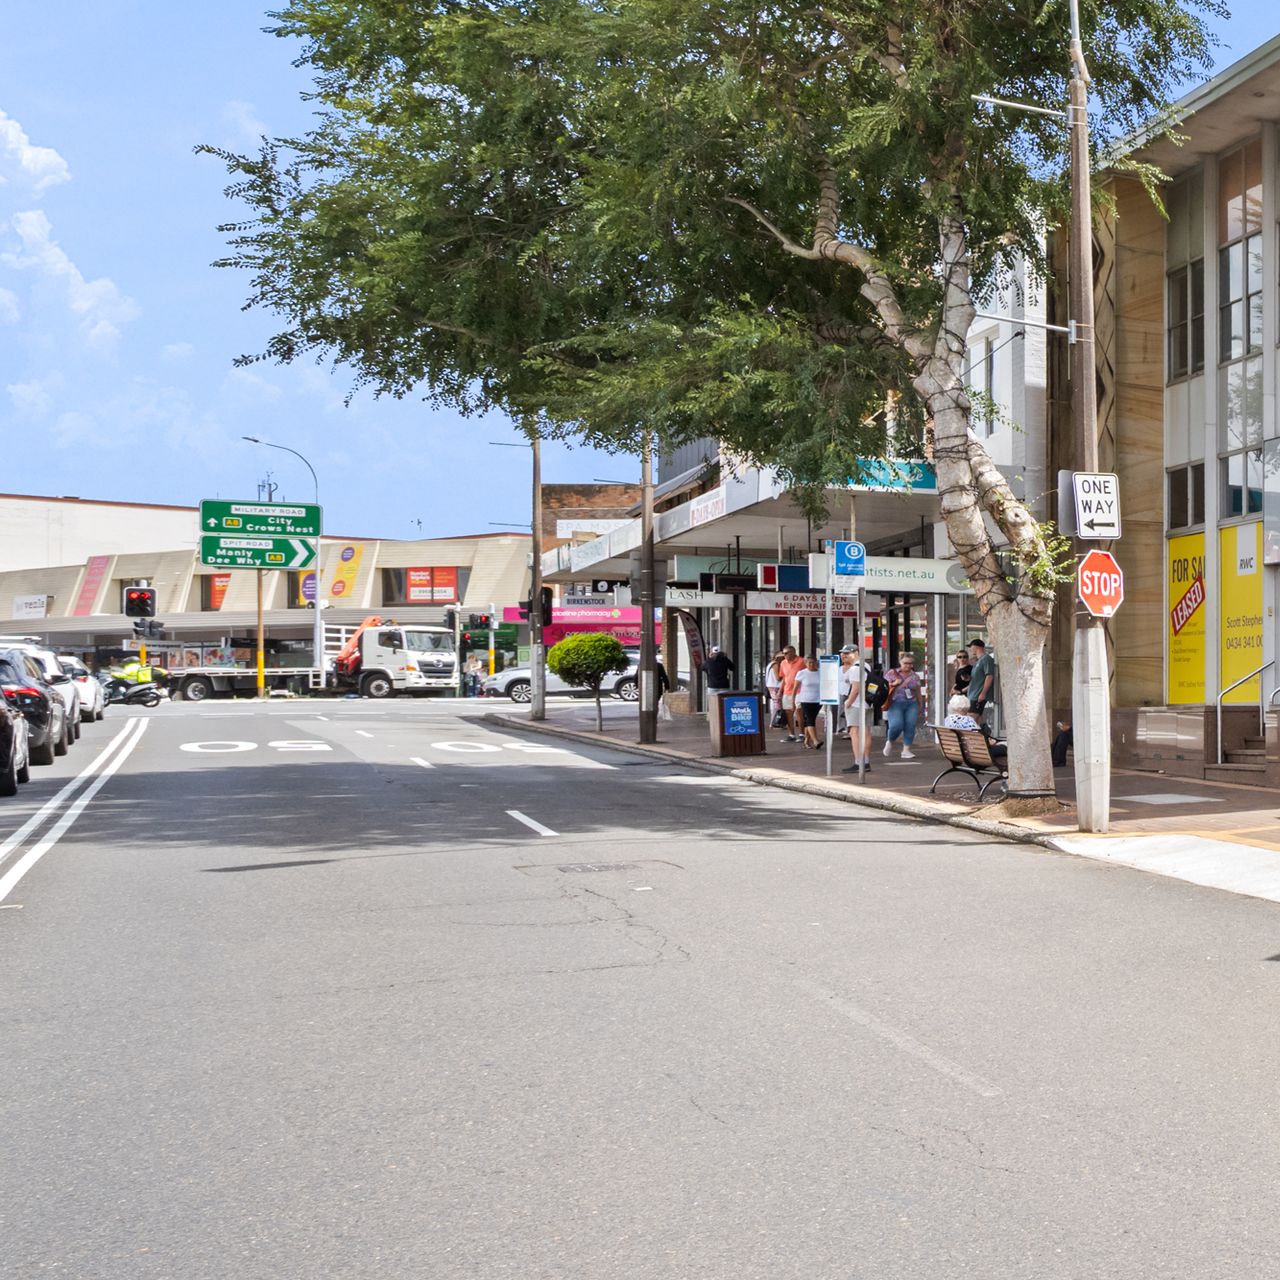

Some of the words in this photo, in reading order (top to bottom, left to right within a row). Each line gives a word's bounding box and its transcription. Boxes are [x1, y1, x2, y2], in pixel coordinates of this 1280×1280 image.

[1081, 479, 1112, 495] ONE
[233, 506, 276, 514] MILITARY
[280, 508, 304, 516] ROAD
[1081, 500, 1114, 514] WAY
[267, 517, 293, 526] City
[246, 524, 282, 532] Crows
[215, 549, 253, 558] Manly
[236, 557, 262, 566] Why
[1239, 557, 1254, 570] RWC
[1172, 559, 1189, 583] FOR
[1082, 570, 1121, 597] STOP
[669, 591, 704, 600] LASH
[792, 594, 818, 602] DAYS
[1172, 581, 1202, 631] LEASED
[577, 609, 610, 618] pharmacy
[1226, 616, 1240, 629] Scott
[1226, 636, 1241, 650] 0434
[1243, 635, 1255, 648] 341
